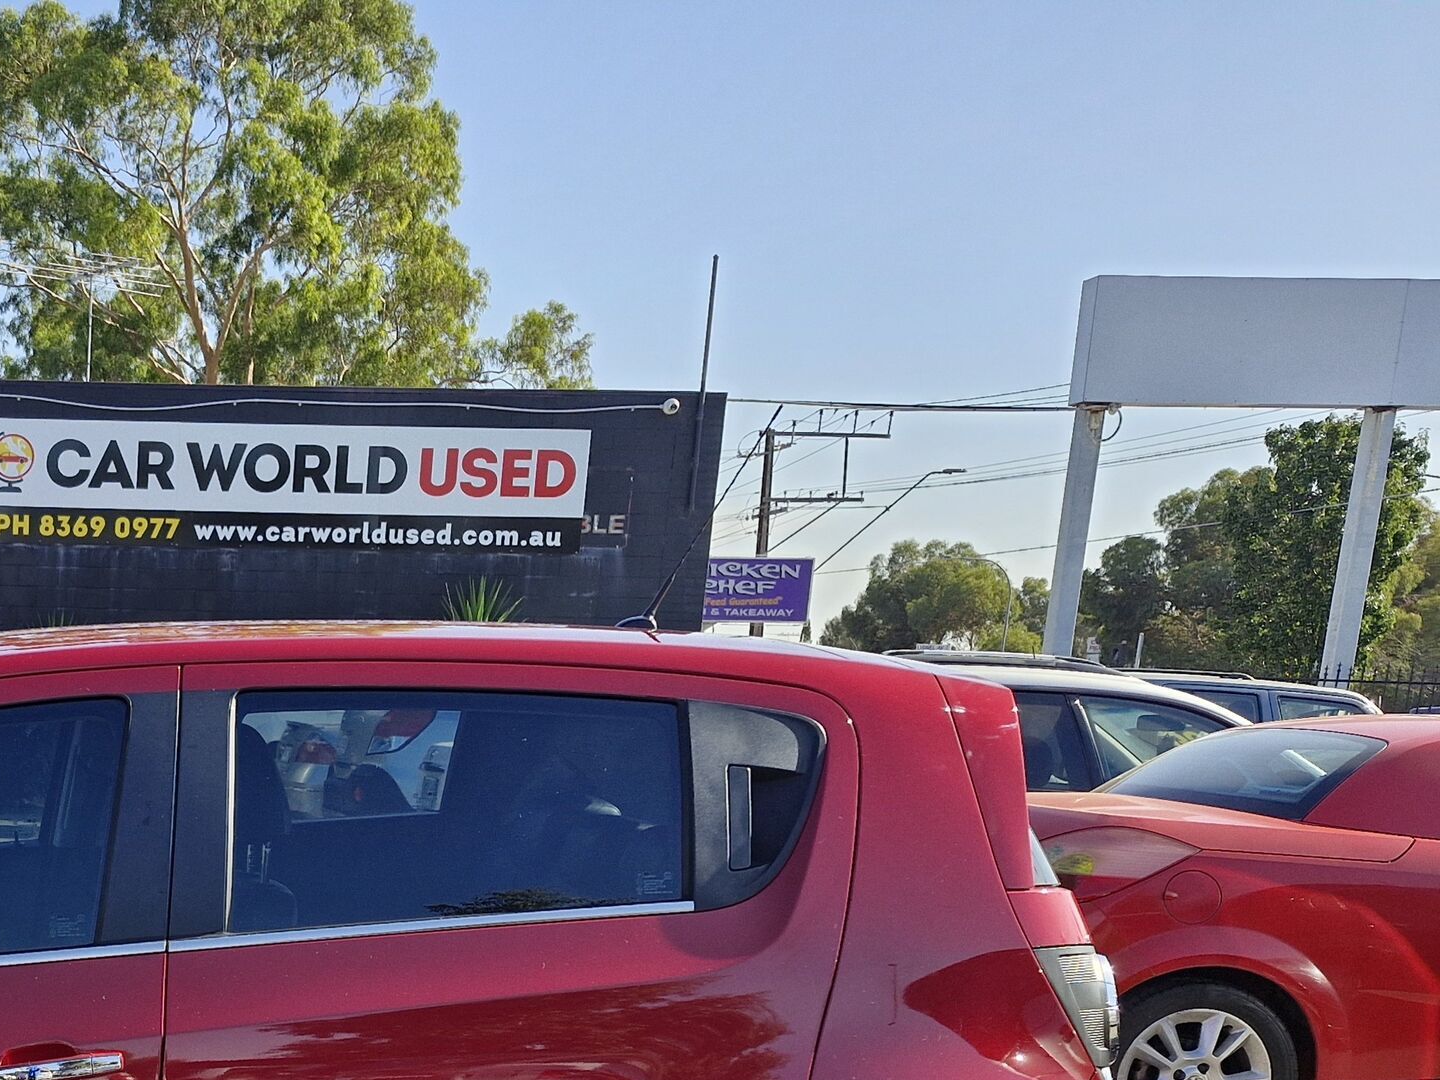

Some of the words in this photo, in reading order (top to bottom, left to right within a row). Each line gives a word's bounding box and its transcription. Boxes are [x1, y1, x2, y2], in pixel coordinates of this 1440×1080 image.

[46, 438, 175, 490] CAR
[186, 441, 408, 495] WORLD
[418, 447, 577, 498] USED
[39, 515, 106, 538] 8369
[114, 517, 180, 539] 0977
[193, 521, 562, 547] www.carworldused.com.au
[580, 514, 625, 534] BLE
[724, 608, 794, 617] TAKEAWAY
